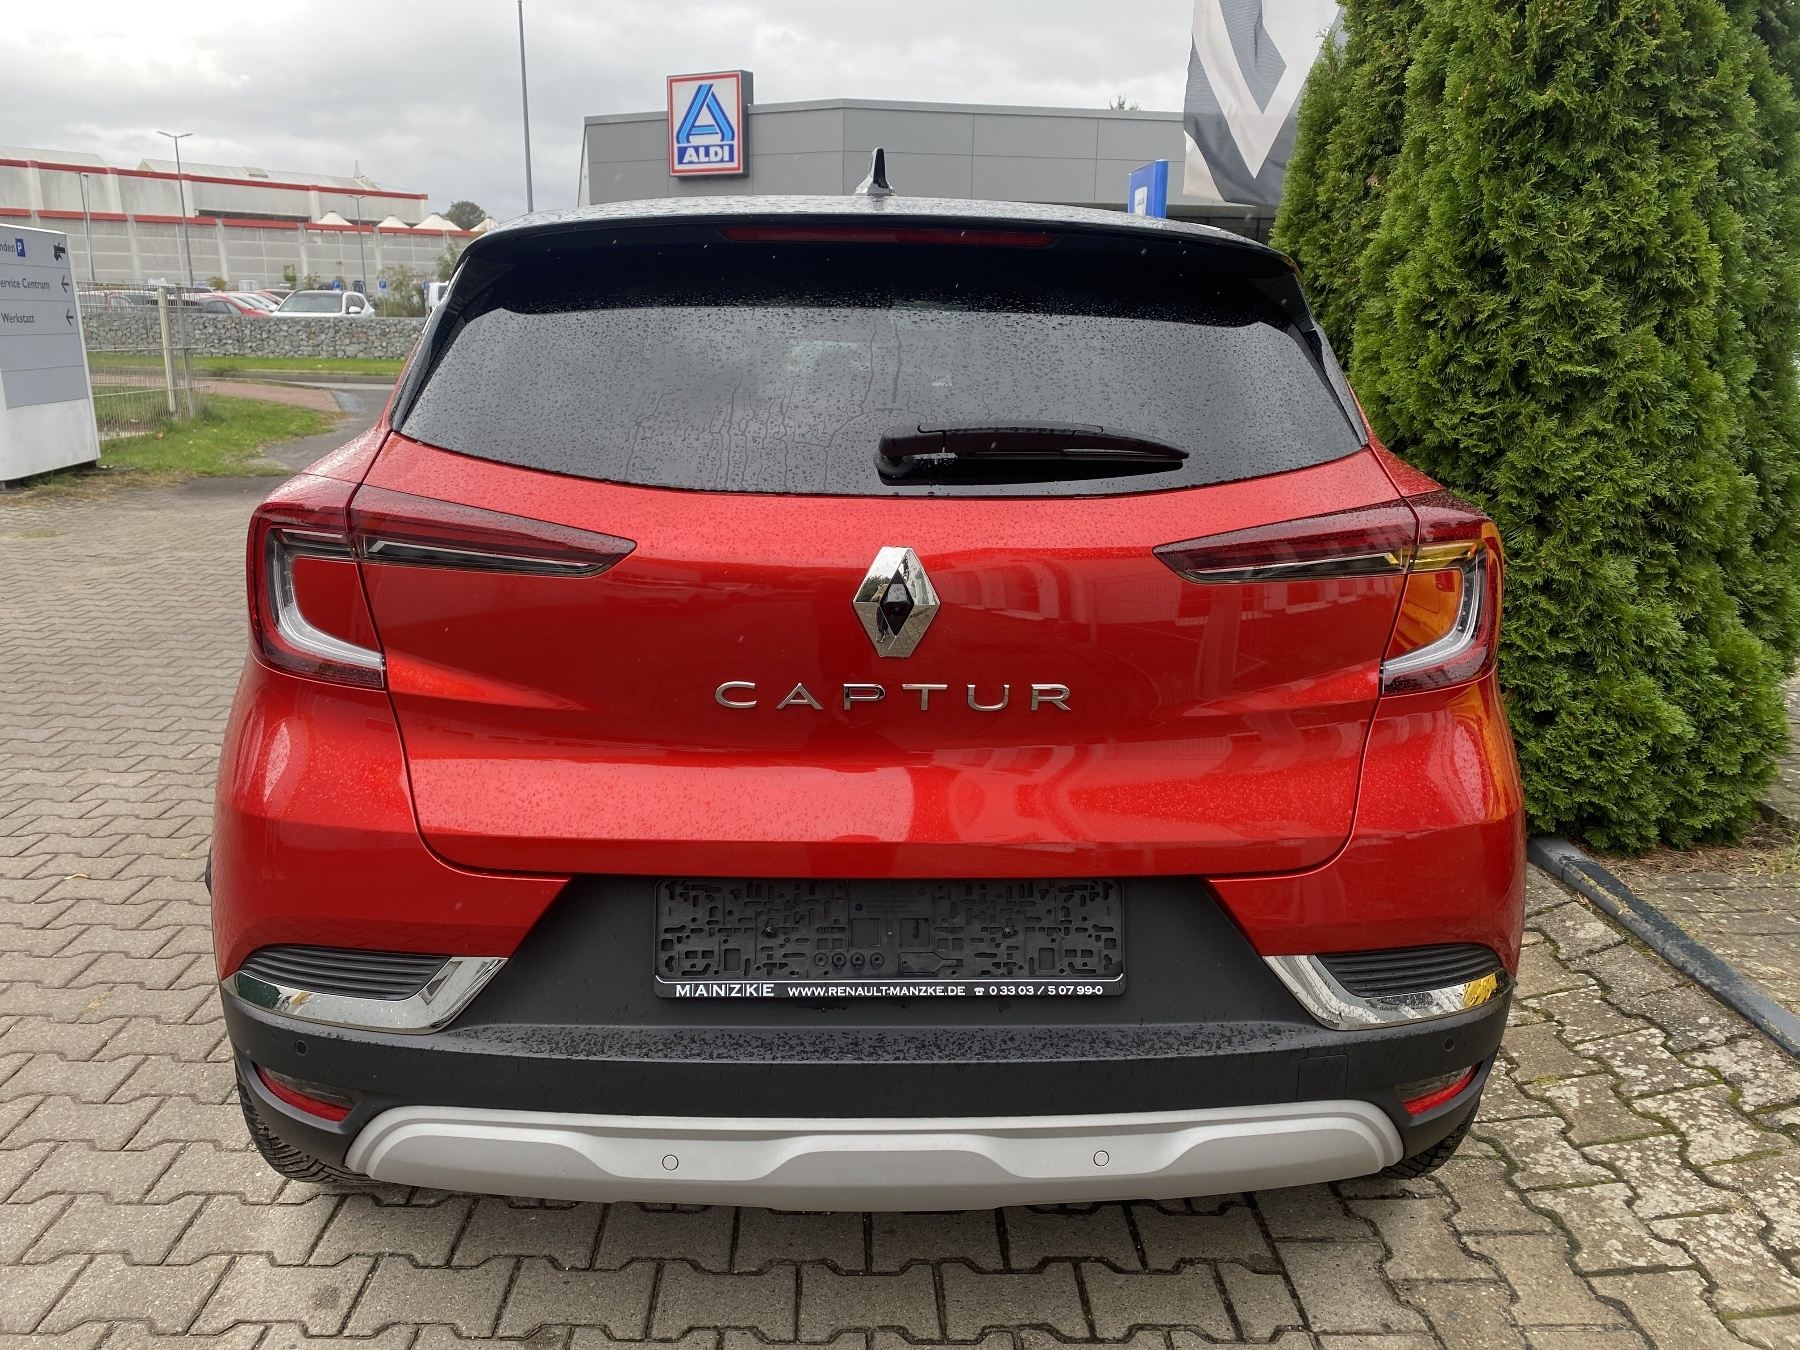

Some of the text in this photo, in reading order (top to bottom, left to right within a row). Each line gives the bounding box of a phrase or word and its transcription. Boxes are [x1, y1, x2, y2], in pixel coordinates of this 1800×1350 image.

[682, 145, 730, 163] ALDI
[21, 278, 51, 290] Centrum
[1, 312, 35, 324] Werkstatt
[714, 680, 1072, 712] CAPTUR
[675, 983, 775, 997] MANZKE
[787, 985, 966, 997] WWW.RENAULT-MANZKE.DE
